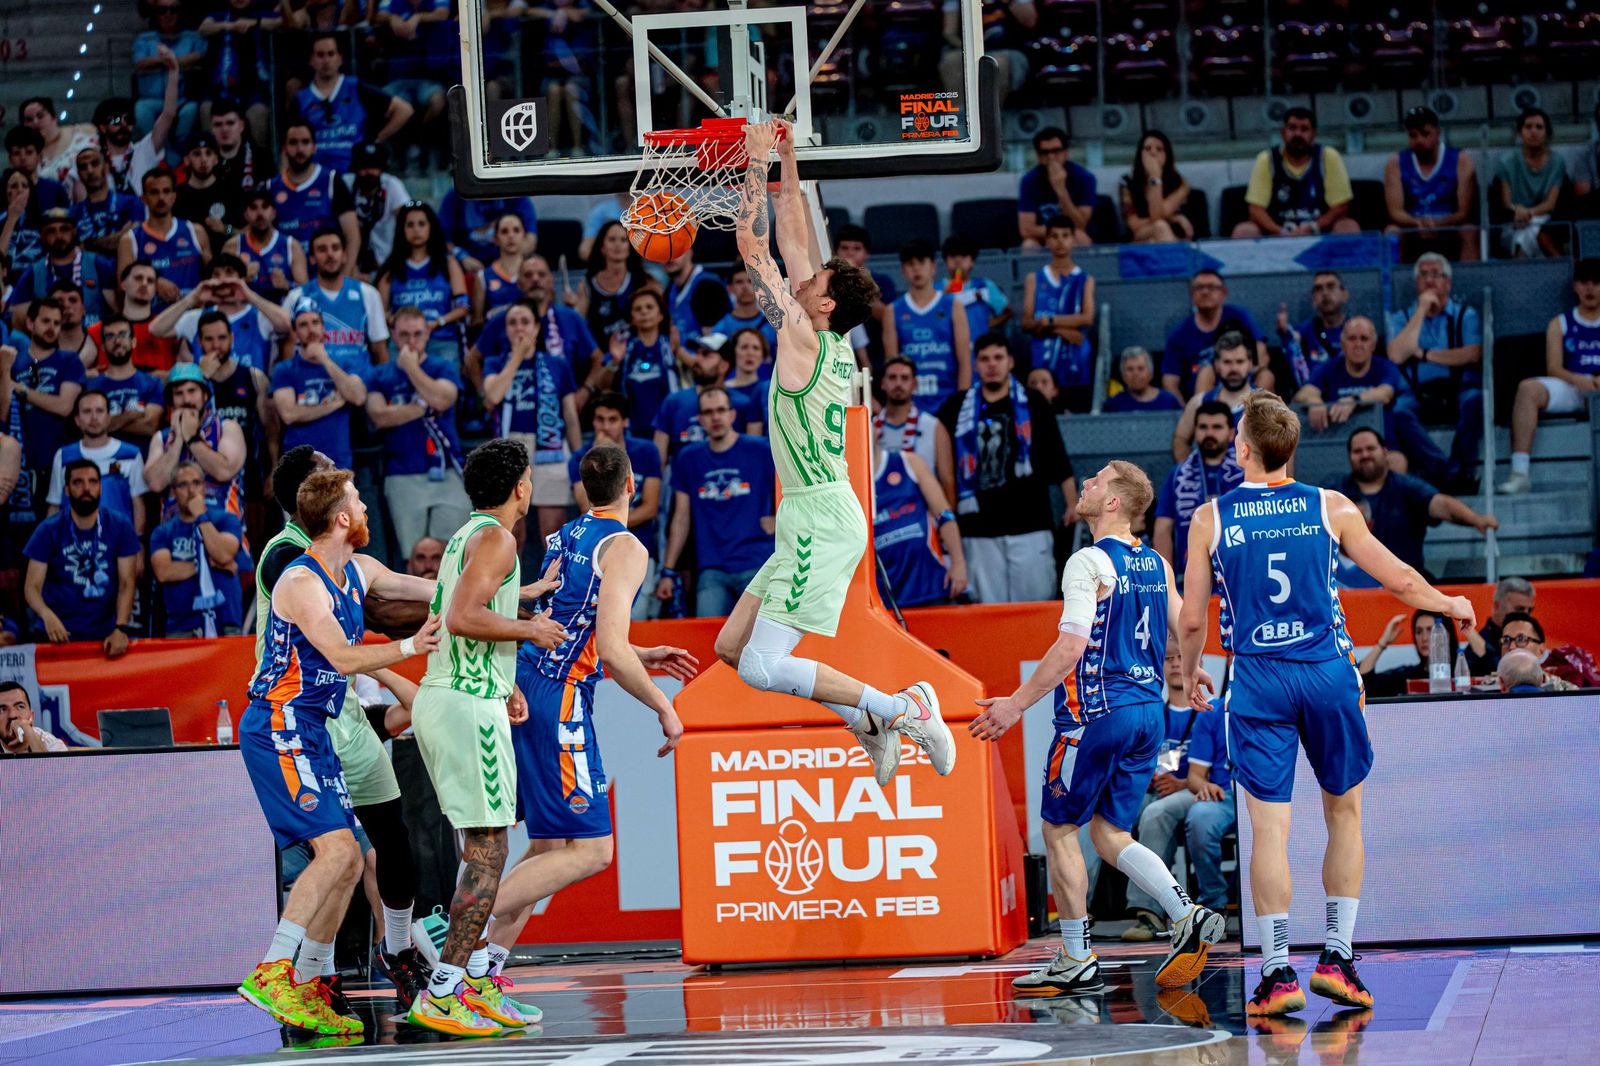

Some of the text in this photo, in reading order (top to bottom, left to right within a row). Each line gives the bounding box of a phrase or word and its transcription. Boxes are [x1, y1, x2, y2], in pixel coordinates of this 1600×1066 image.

[900, 100, 960, 115] FINAL
[901, 114, 959, 130] FOUR
[901, 129, 960, 139] PRIMERA FEB
[824, 402, 844, 456] 9
[1233, 497, 1307, 519] ZURBRIGGEN
[1268, 552, 1291, 604] 5
[1134, 606, 1151, 650] 4
[711, 744, 932, 772] MADRID225
[711, 775, 943, 827] FINAL
[714, 835, 938, 887] FOUR
[716, 895, 941, 922] PRIMERA FEB
